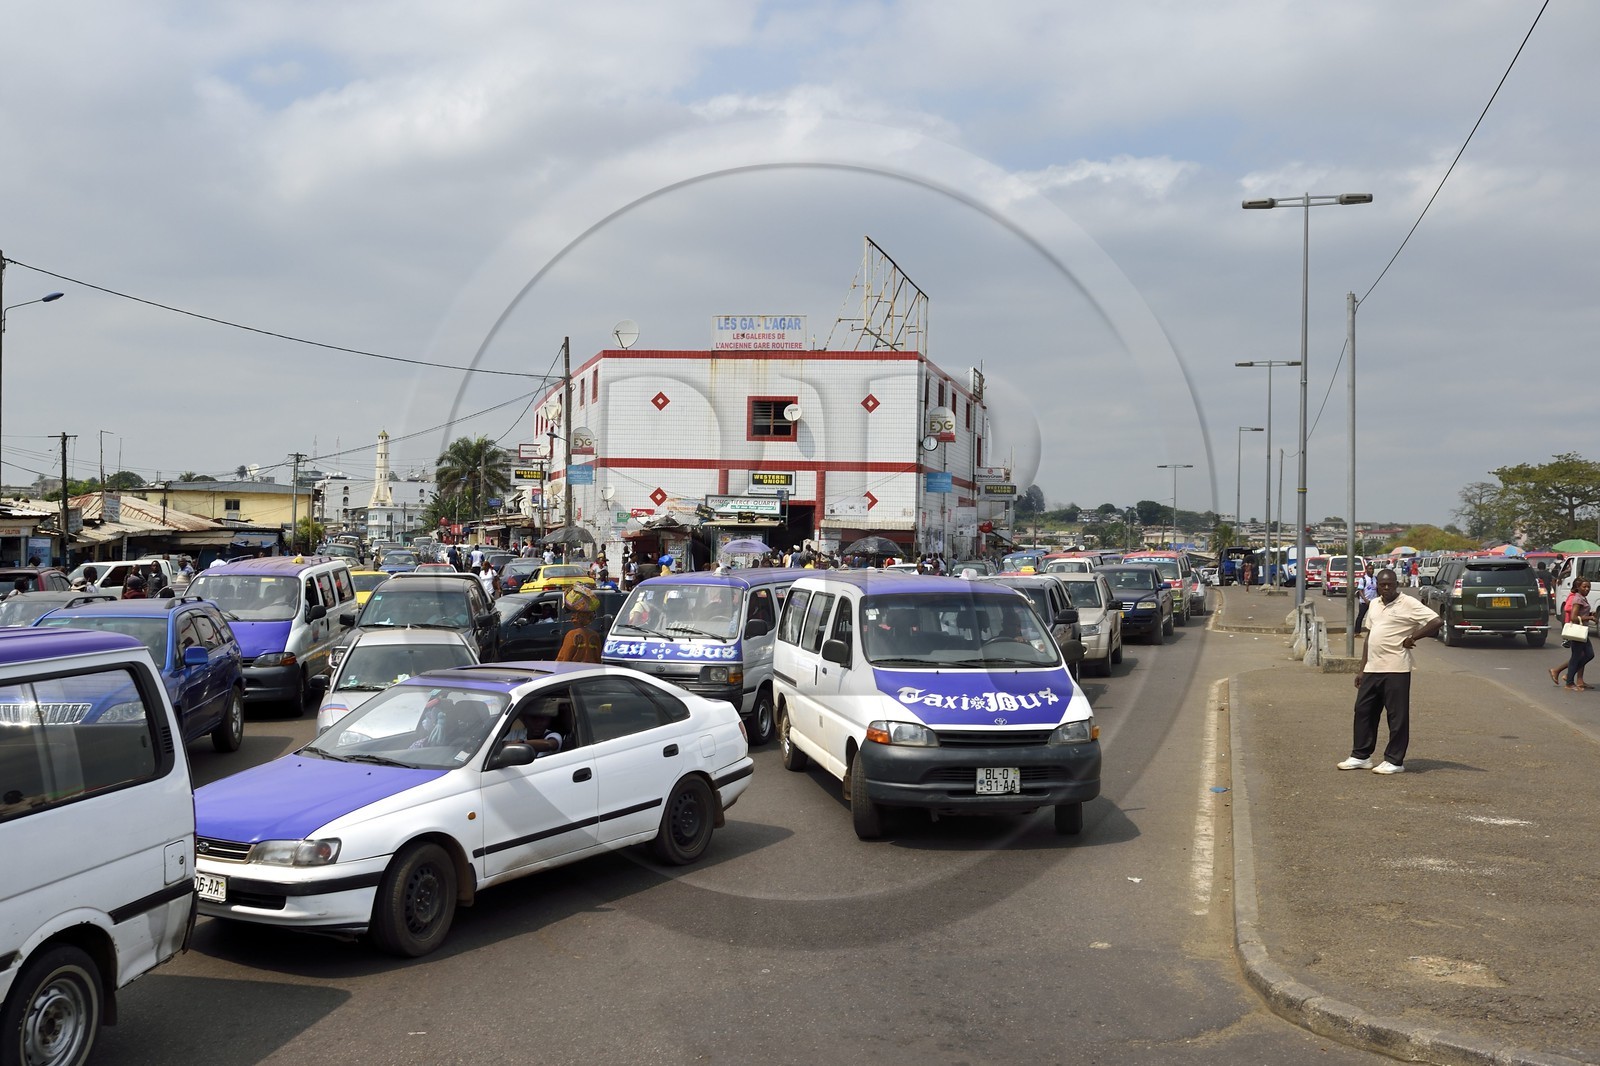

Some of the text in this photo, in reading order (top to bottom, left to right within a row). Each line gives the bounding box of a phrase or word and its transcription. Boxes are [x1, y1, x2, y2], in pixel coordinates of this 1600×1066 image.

[718, 318, 737, 330] LES
[740, 317, 755, 330] GA
[764, 317, 801, 330] L'AGAR
[732, 332, 786, 340] LES GALERIES DE
[715, 342, 803, 350] L'ANCIENNE GARE ROUTIERE
[603, 640, 738, 659] Taxi Bus
[896, 686, 1060, 712] Taxi Bus
[986, 779, 1016, 791] 91-AA
